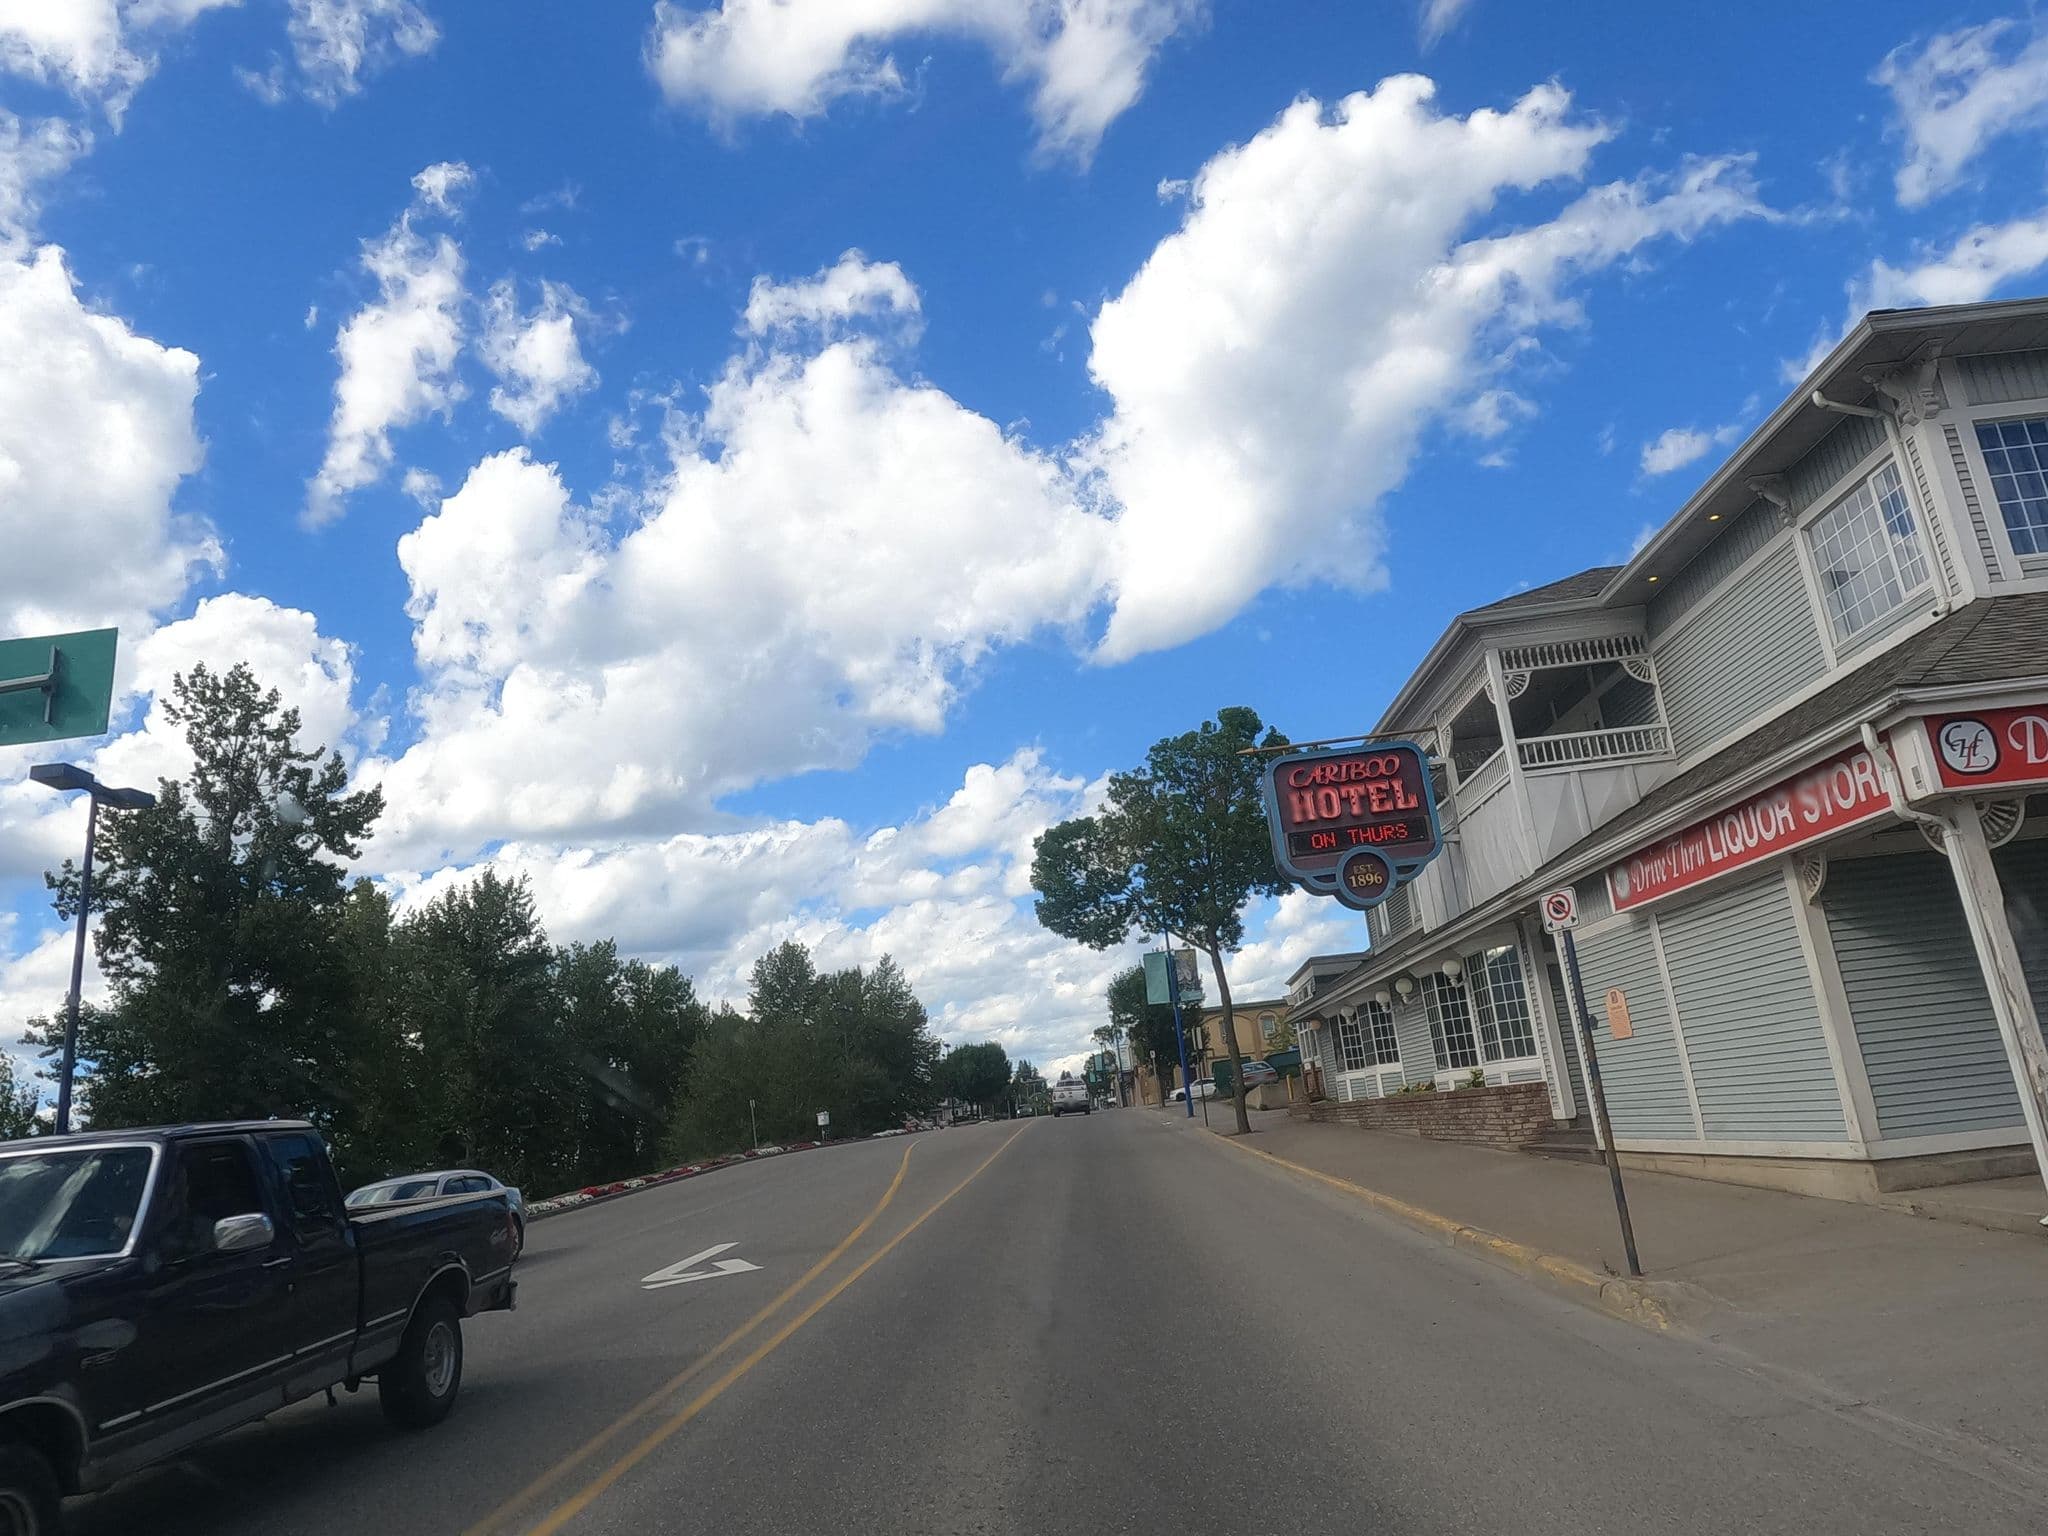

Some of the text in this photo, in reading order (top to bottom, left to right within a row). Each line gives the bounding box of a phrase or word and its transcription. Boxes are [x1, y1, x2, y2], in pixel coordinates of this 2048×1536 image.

[1288, 755, 1400, 788] CARIBOO
[1287, 779, 1419, 823] HOTEL
[1311, 823, 1409, 849] ON THURS
[1631, 851, 1667, 892] Drive
[1664, 829, 1705, 878] Thru
[1705, 792, 1796, 863] LIQUOR
[1349, 871, 1383, 888] 1896
